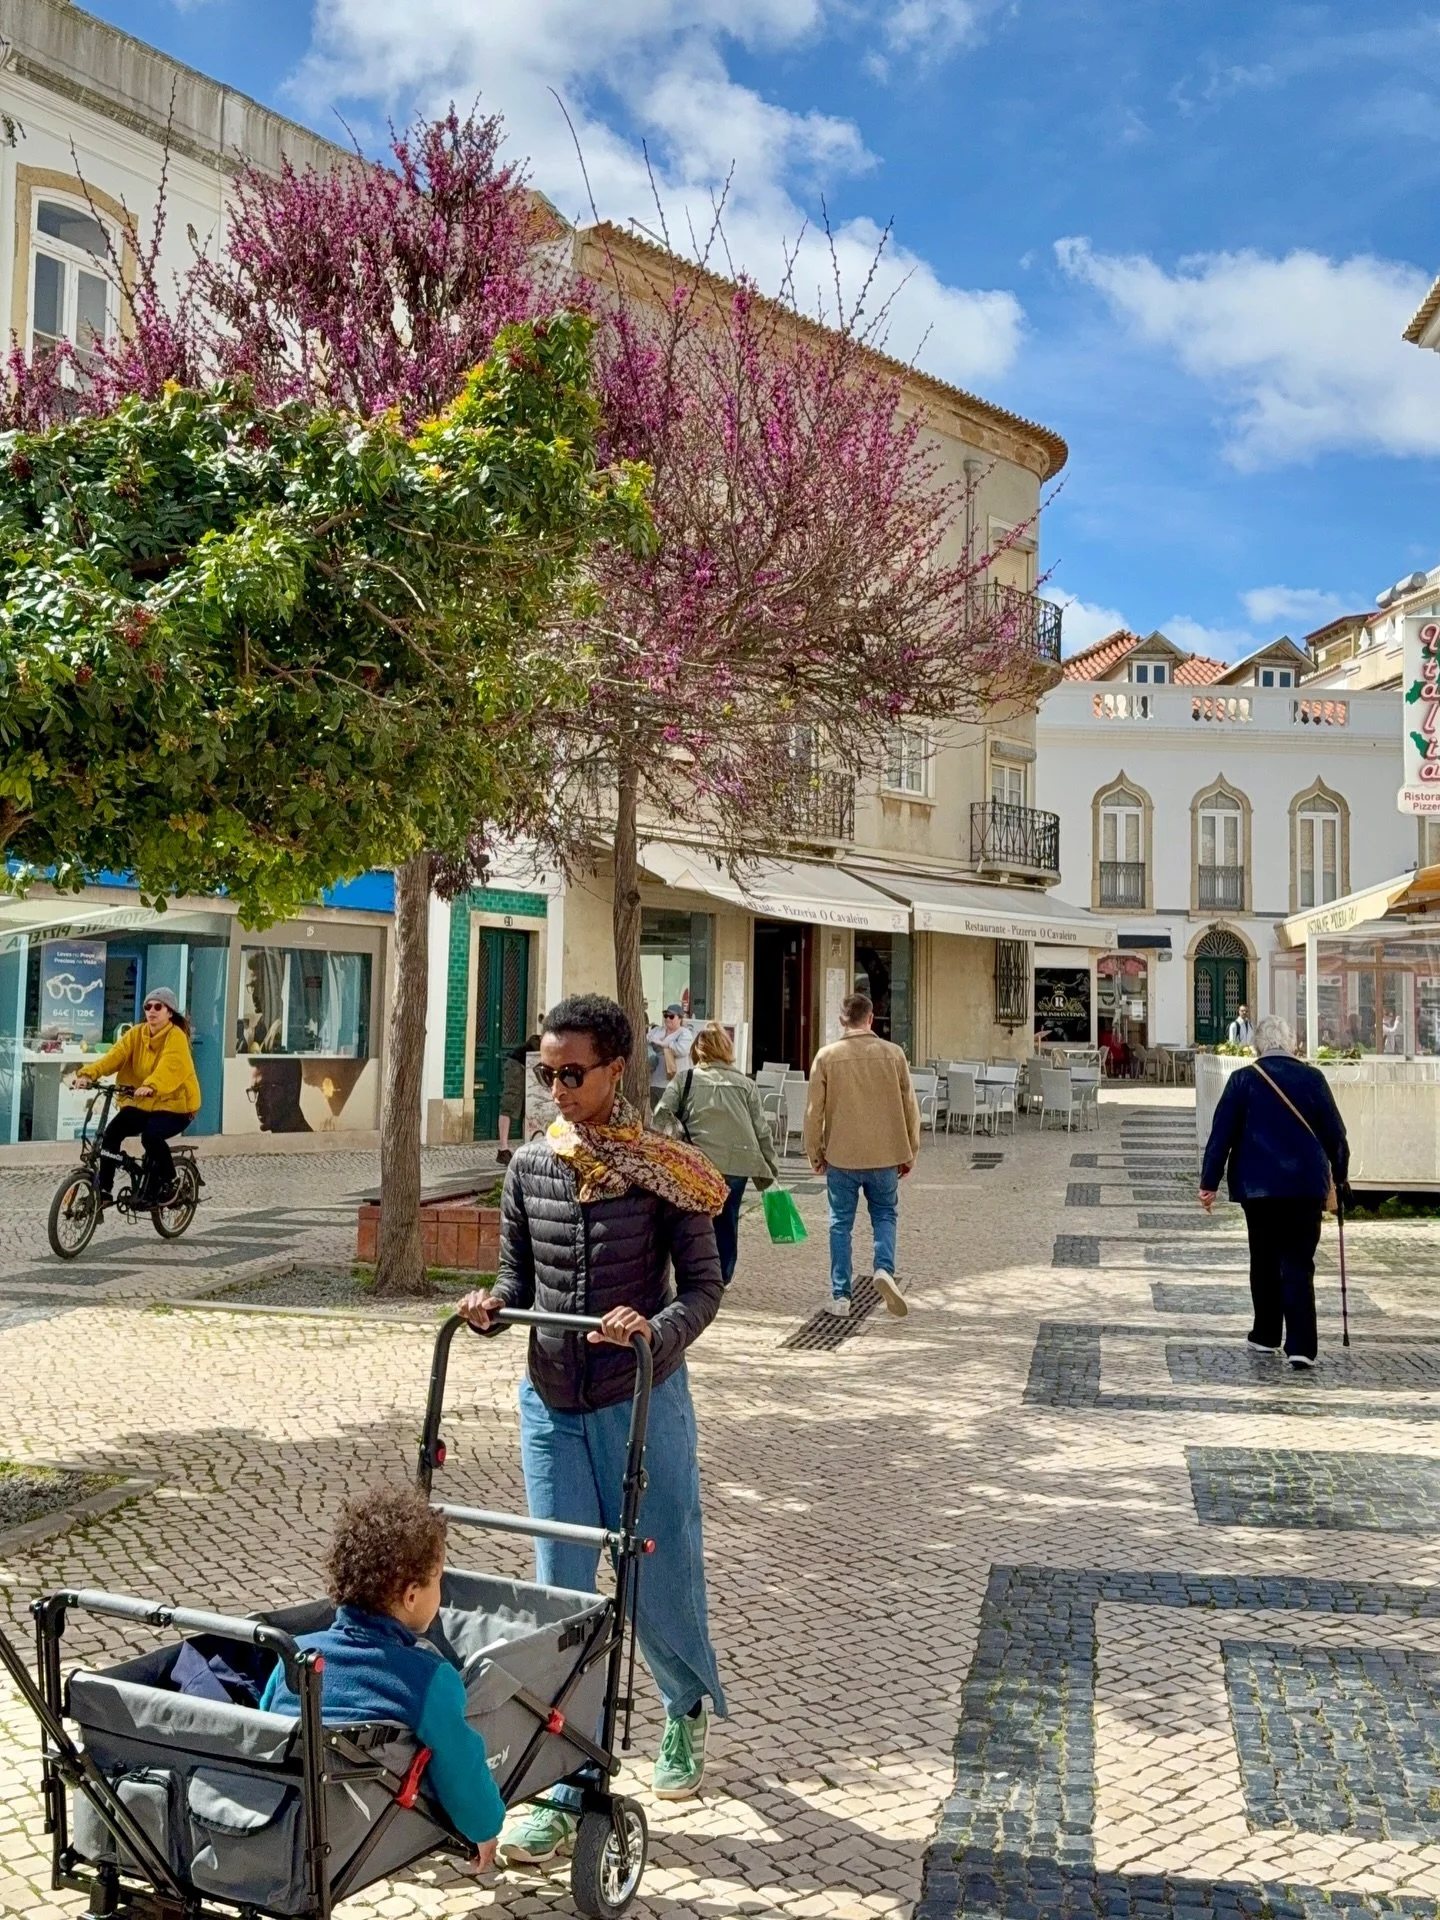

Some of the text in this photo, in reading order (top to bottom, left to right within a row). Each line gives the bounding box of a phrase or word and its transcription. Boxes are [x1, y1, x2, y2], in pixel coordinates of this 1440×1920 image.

[783, 904, 817, 919] Pizzeria
[820, 911, 828, 921] O
[830, 910, 869, 925] Cavaleiro
[964, 920, 1006, 935] Restaurante
[1011, 924, 1037, 937] Pizzeria
[1039, 928, 1046, 938] O
[1047, 929, 1077, 941] Cavaleiro
[1054, 996, 1064, 1008] R
